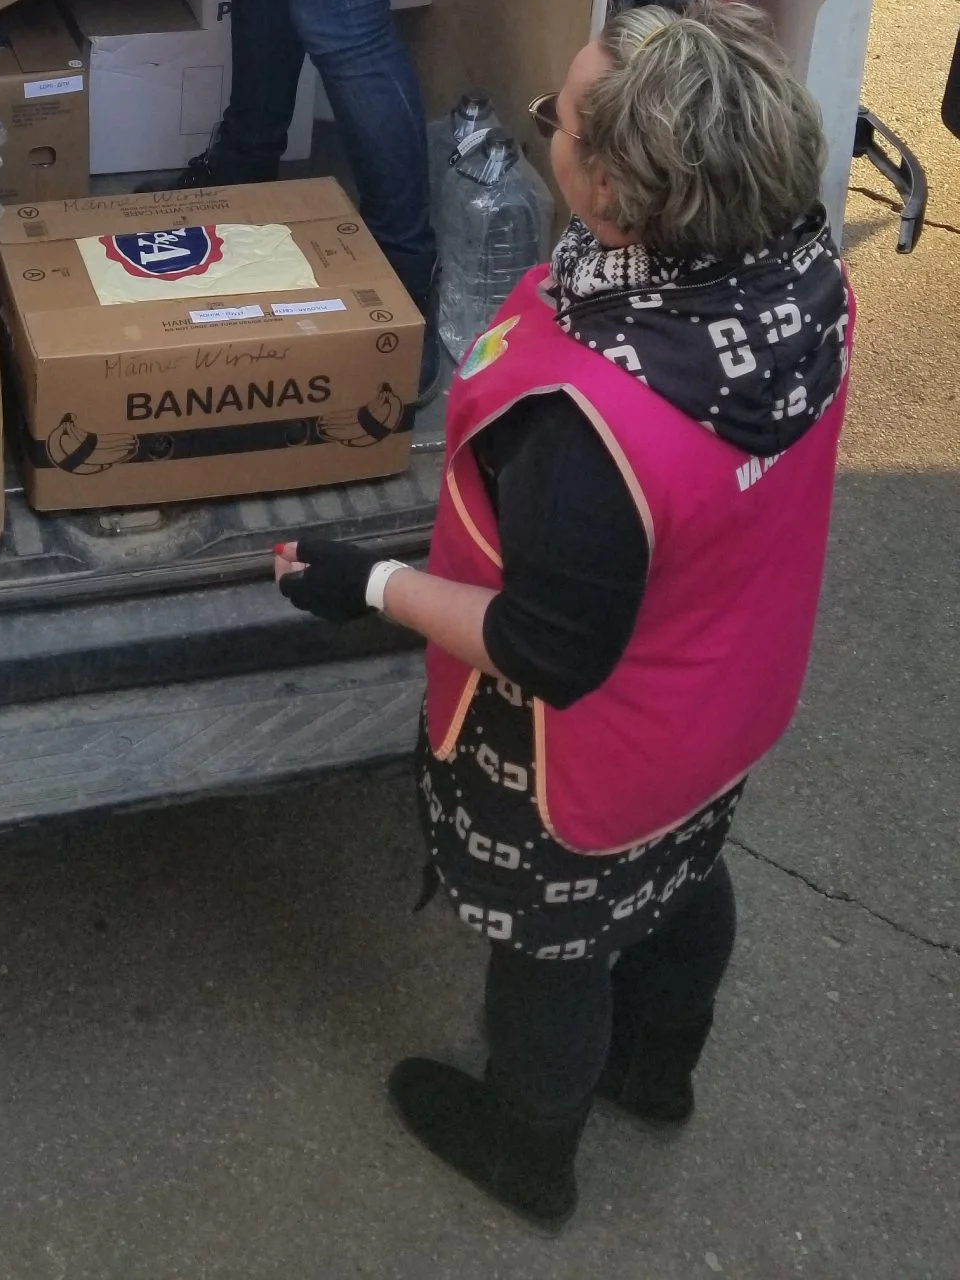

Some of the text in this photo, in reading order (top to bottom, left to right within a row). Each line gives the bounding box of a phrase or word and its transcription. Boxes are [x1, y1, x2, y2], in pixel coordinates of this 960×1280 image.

[138, 228, 191, 265] &A
[162, 315, 195, 327] HAN
[195, 343, 290, 369] Winter
[126, 374, 332, 420] BANANAS
